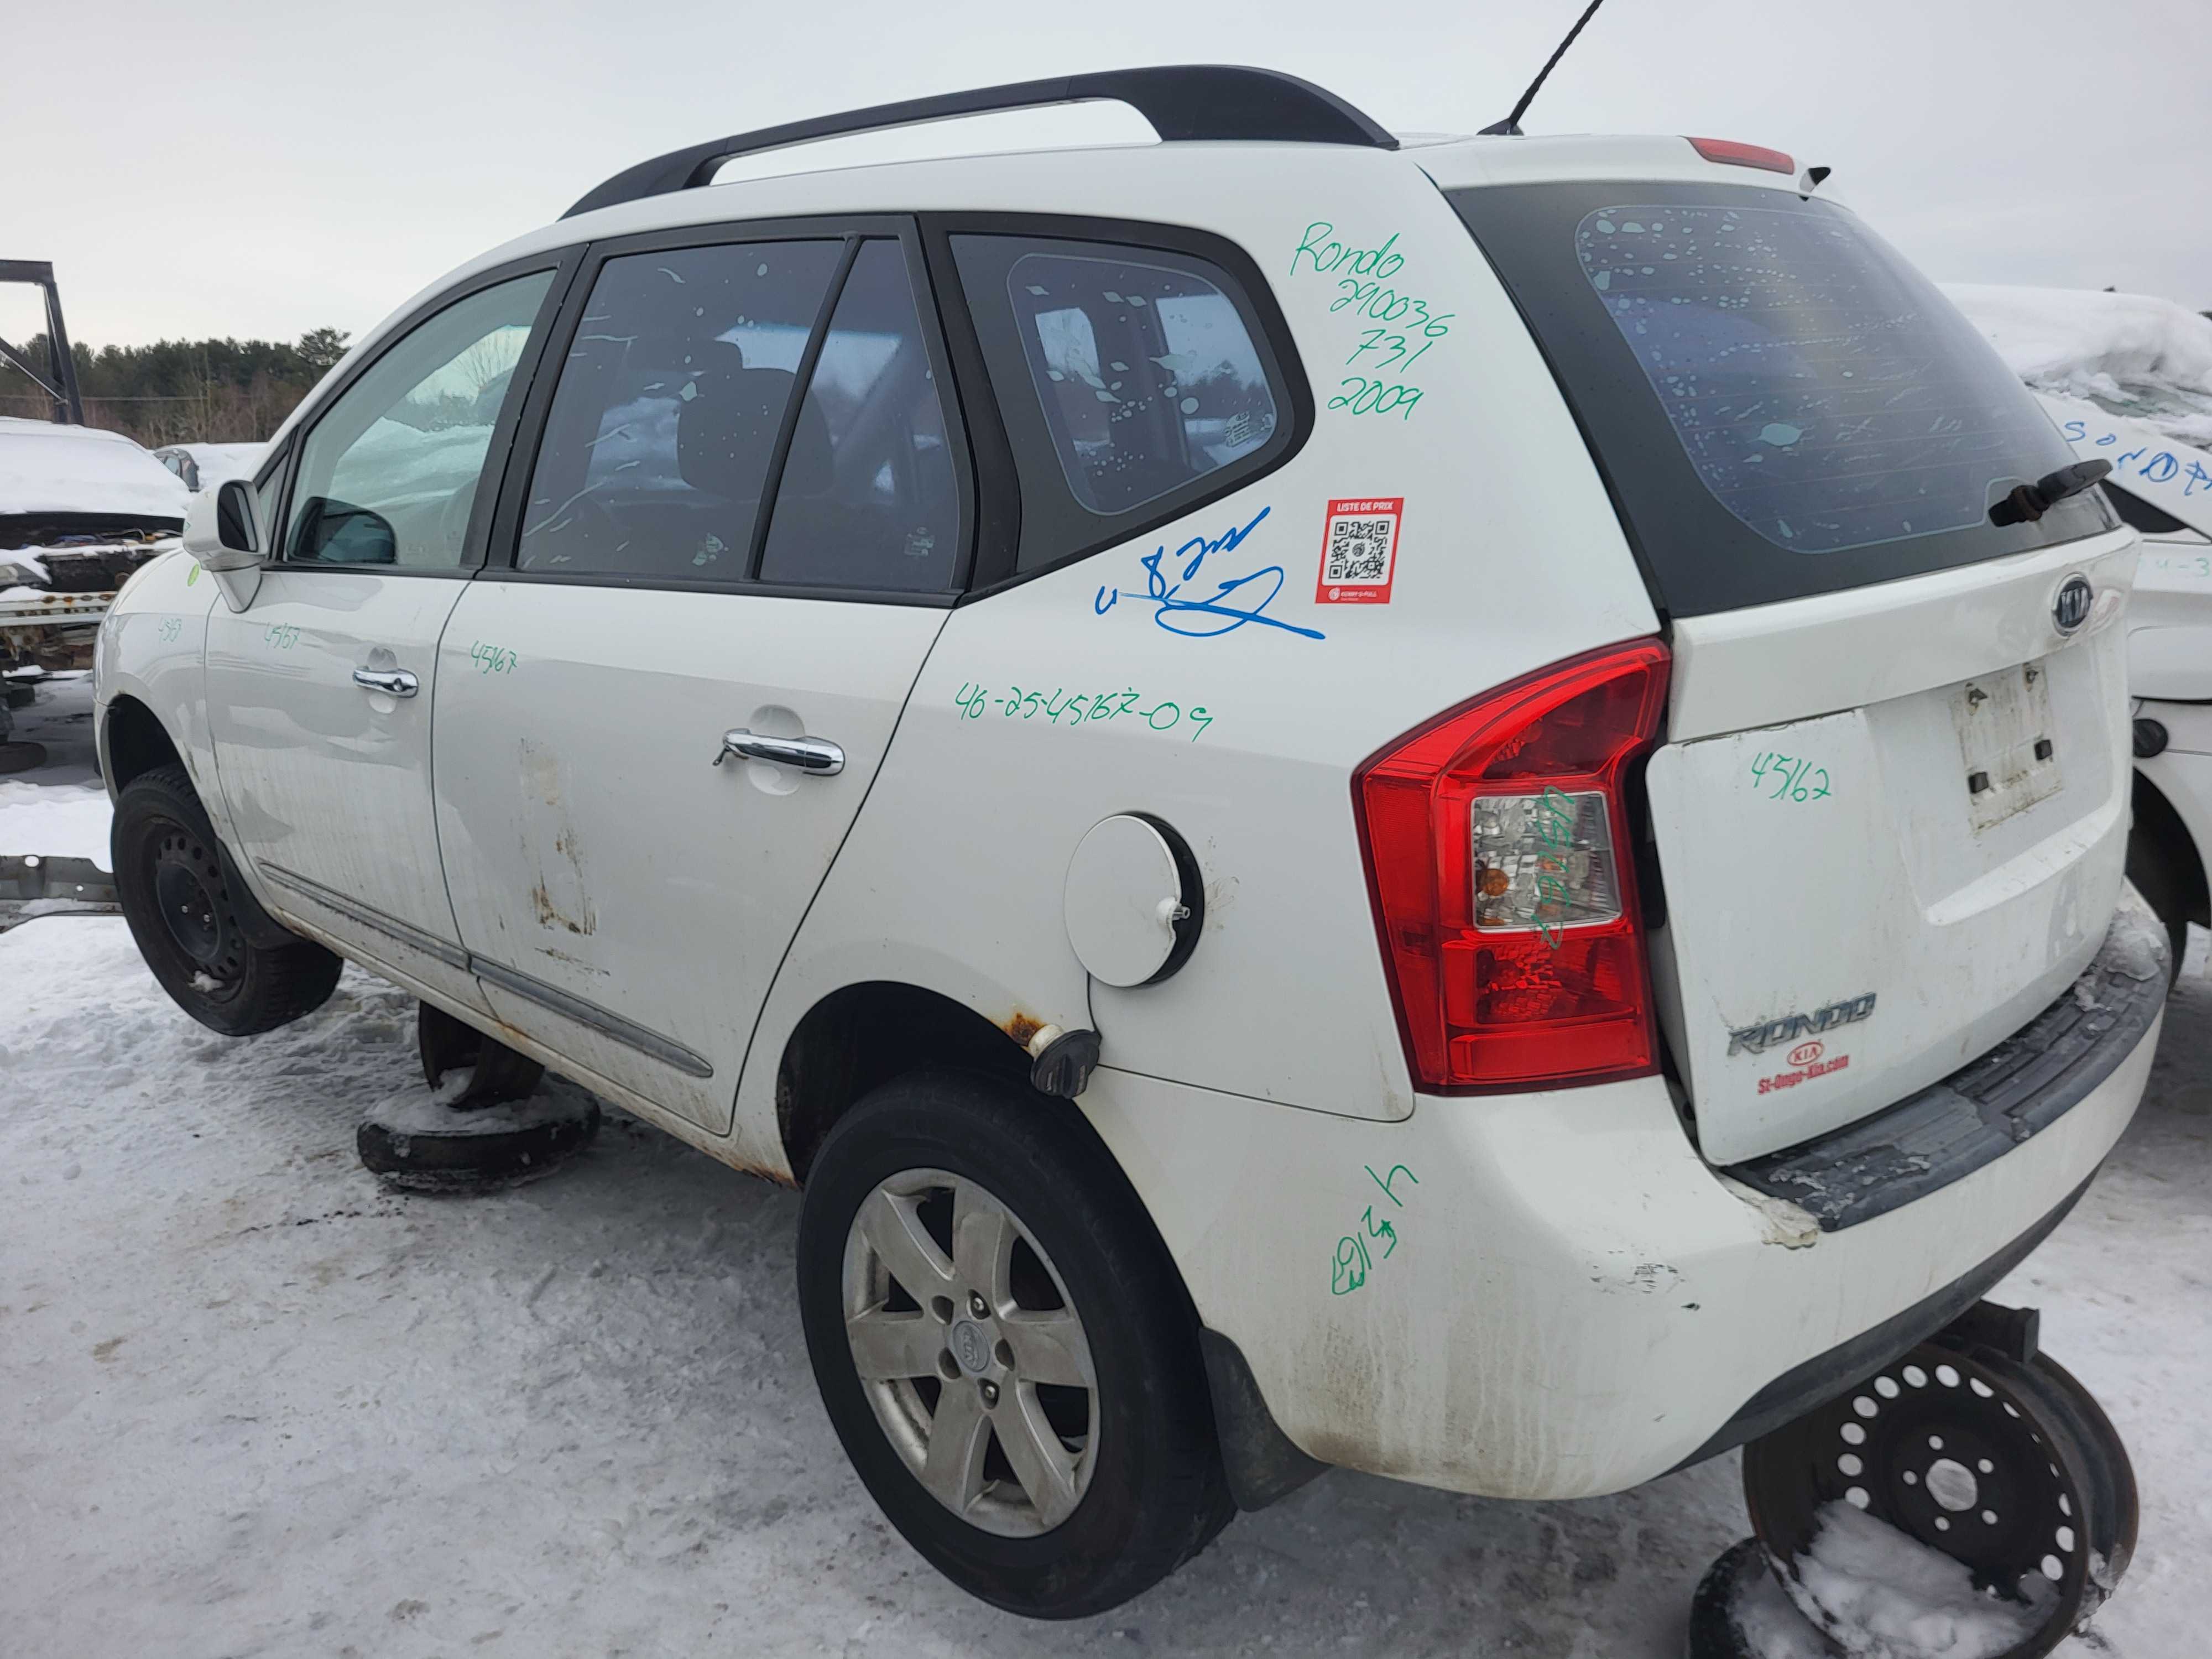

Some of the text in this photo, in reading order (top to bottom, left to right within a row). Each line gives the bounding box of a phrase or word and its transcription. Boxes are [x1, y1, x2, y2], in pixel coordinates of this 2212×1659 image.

[1290, 222, 1405, 279] Rondo
[1329, 279, 1456, 337] 290036
[1345, 328, 1433, 374] 731
[1327, 377, 1424, 421] 2009
[1337, 501, 1394, 512] LISTE DE PRIX
[1727, 992, 1877, 1057] RONDO
